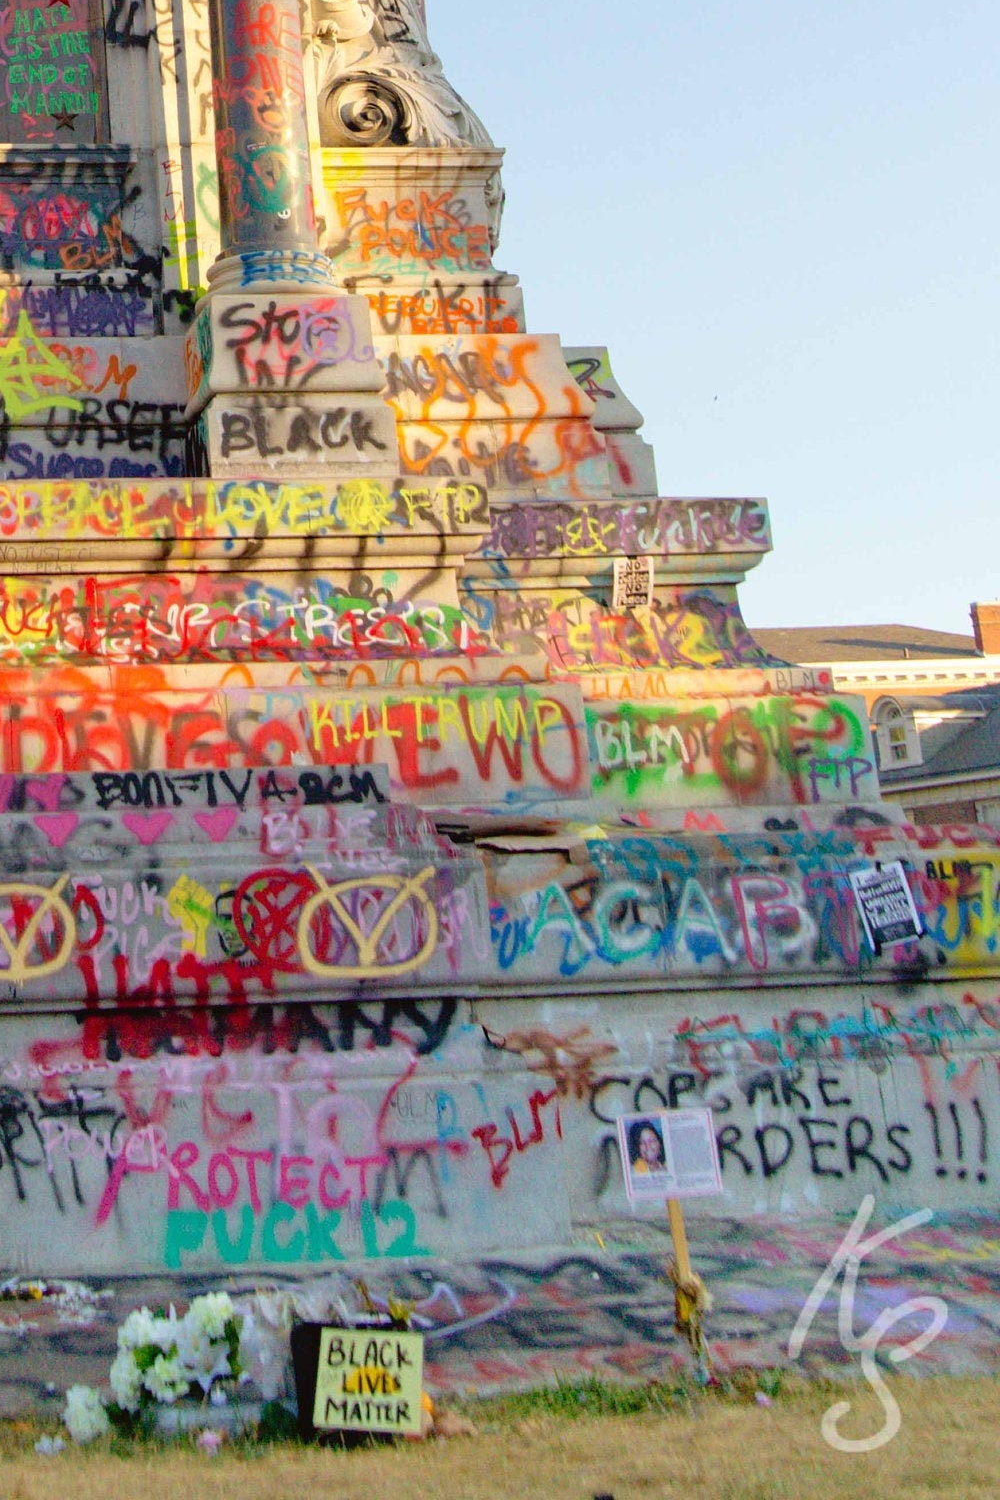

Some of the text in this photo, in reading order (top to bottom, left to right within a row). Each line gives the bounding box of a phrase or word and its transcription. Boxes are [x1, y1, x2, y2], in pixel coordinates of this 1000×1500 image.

[15, 6, 73, 35] HATE
[42, 31, 91, 58] THE
[8, 63, 90, 86] END OF
[220, 407, 387, 459] BLACK
[204, 482, 332, 532] LOVE
[400, 484, 480, 527] FTP
[626, 560, 641, 571] NO
[625, 583, 642, 593] NO
[775, 669, 817, 693] BLM
[309, 698, 403, 751] KILL
[405, 696, 563, 746] TRUMP
[595, 721, 691, 776] BLM
[808, 756, 873, 801] FTP
[472, 1088, 563, 1189] BLM
[361, 1199, 432, 1258] 12
[327, 1336, 413, 1369] BLACK
[341, 1369, 403, 1395] LIVES
[325, 1396, 412, 1423] MATTER
